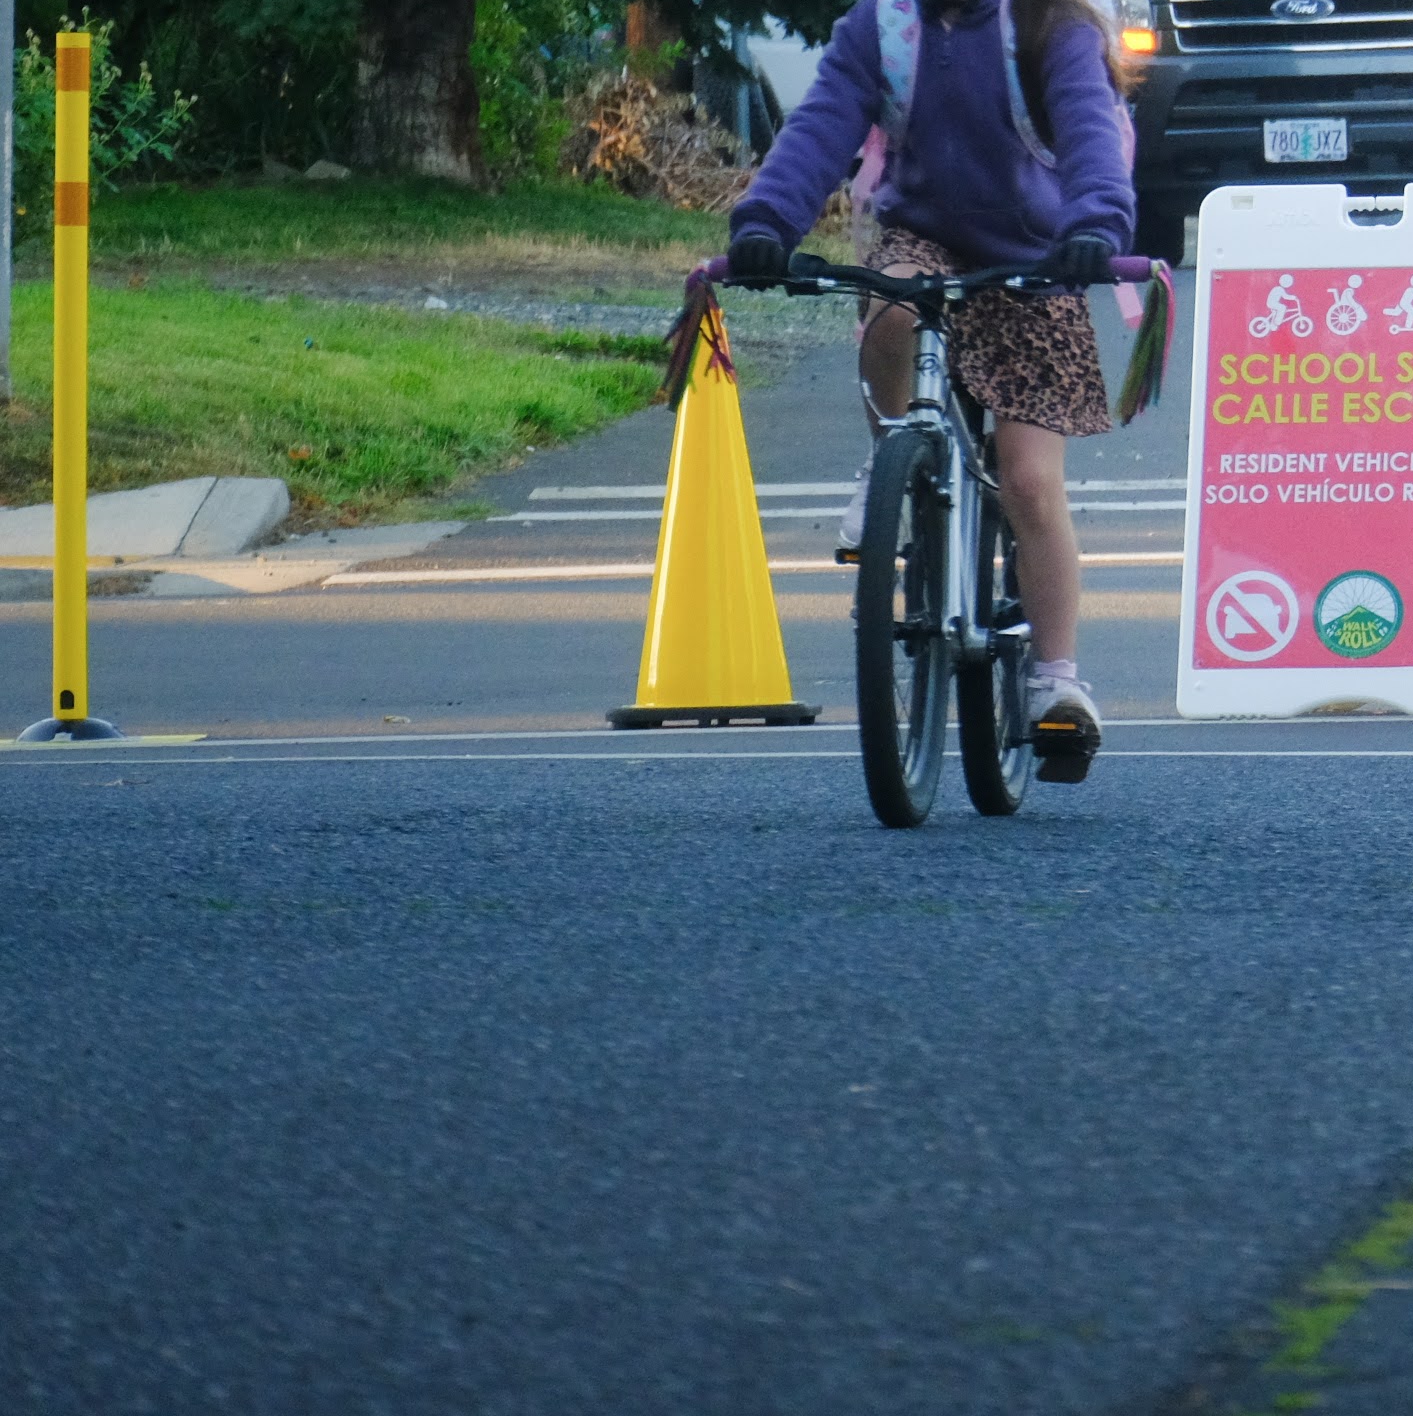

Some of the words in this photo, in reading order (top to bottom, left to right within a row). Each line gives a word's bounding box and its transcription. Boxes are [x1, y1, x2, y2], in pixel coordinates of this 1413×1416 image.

[1286, 0, 1318, 15] Ford
[1270, 130, 1299, 152] 780
[1313, 130, 1342, 152] JXZ
[1219, 353, 1383, 385] SCHOOL
[1212, 393, 1328, 425] CALLE
[1220, 453, 1328, 474] RESIDENT
[1205, 484, 1269, 504] SOLO
[1277, 478, 1395, 503] VEHÍCULO
[1343, 621, 1377, 632] WALK
[1338, 631, 1381, 649] ROLL
